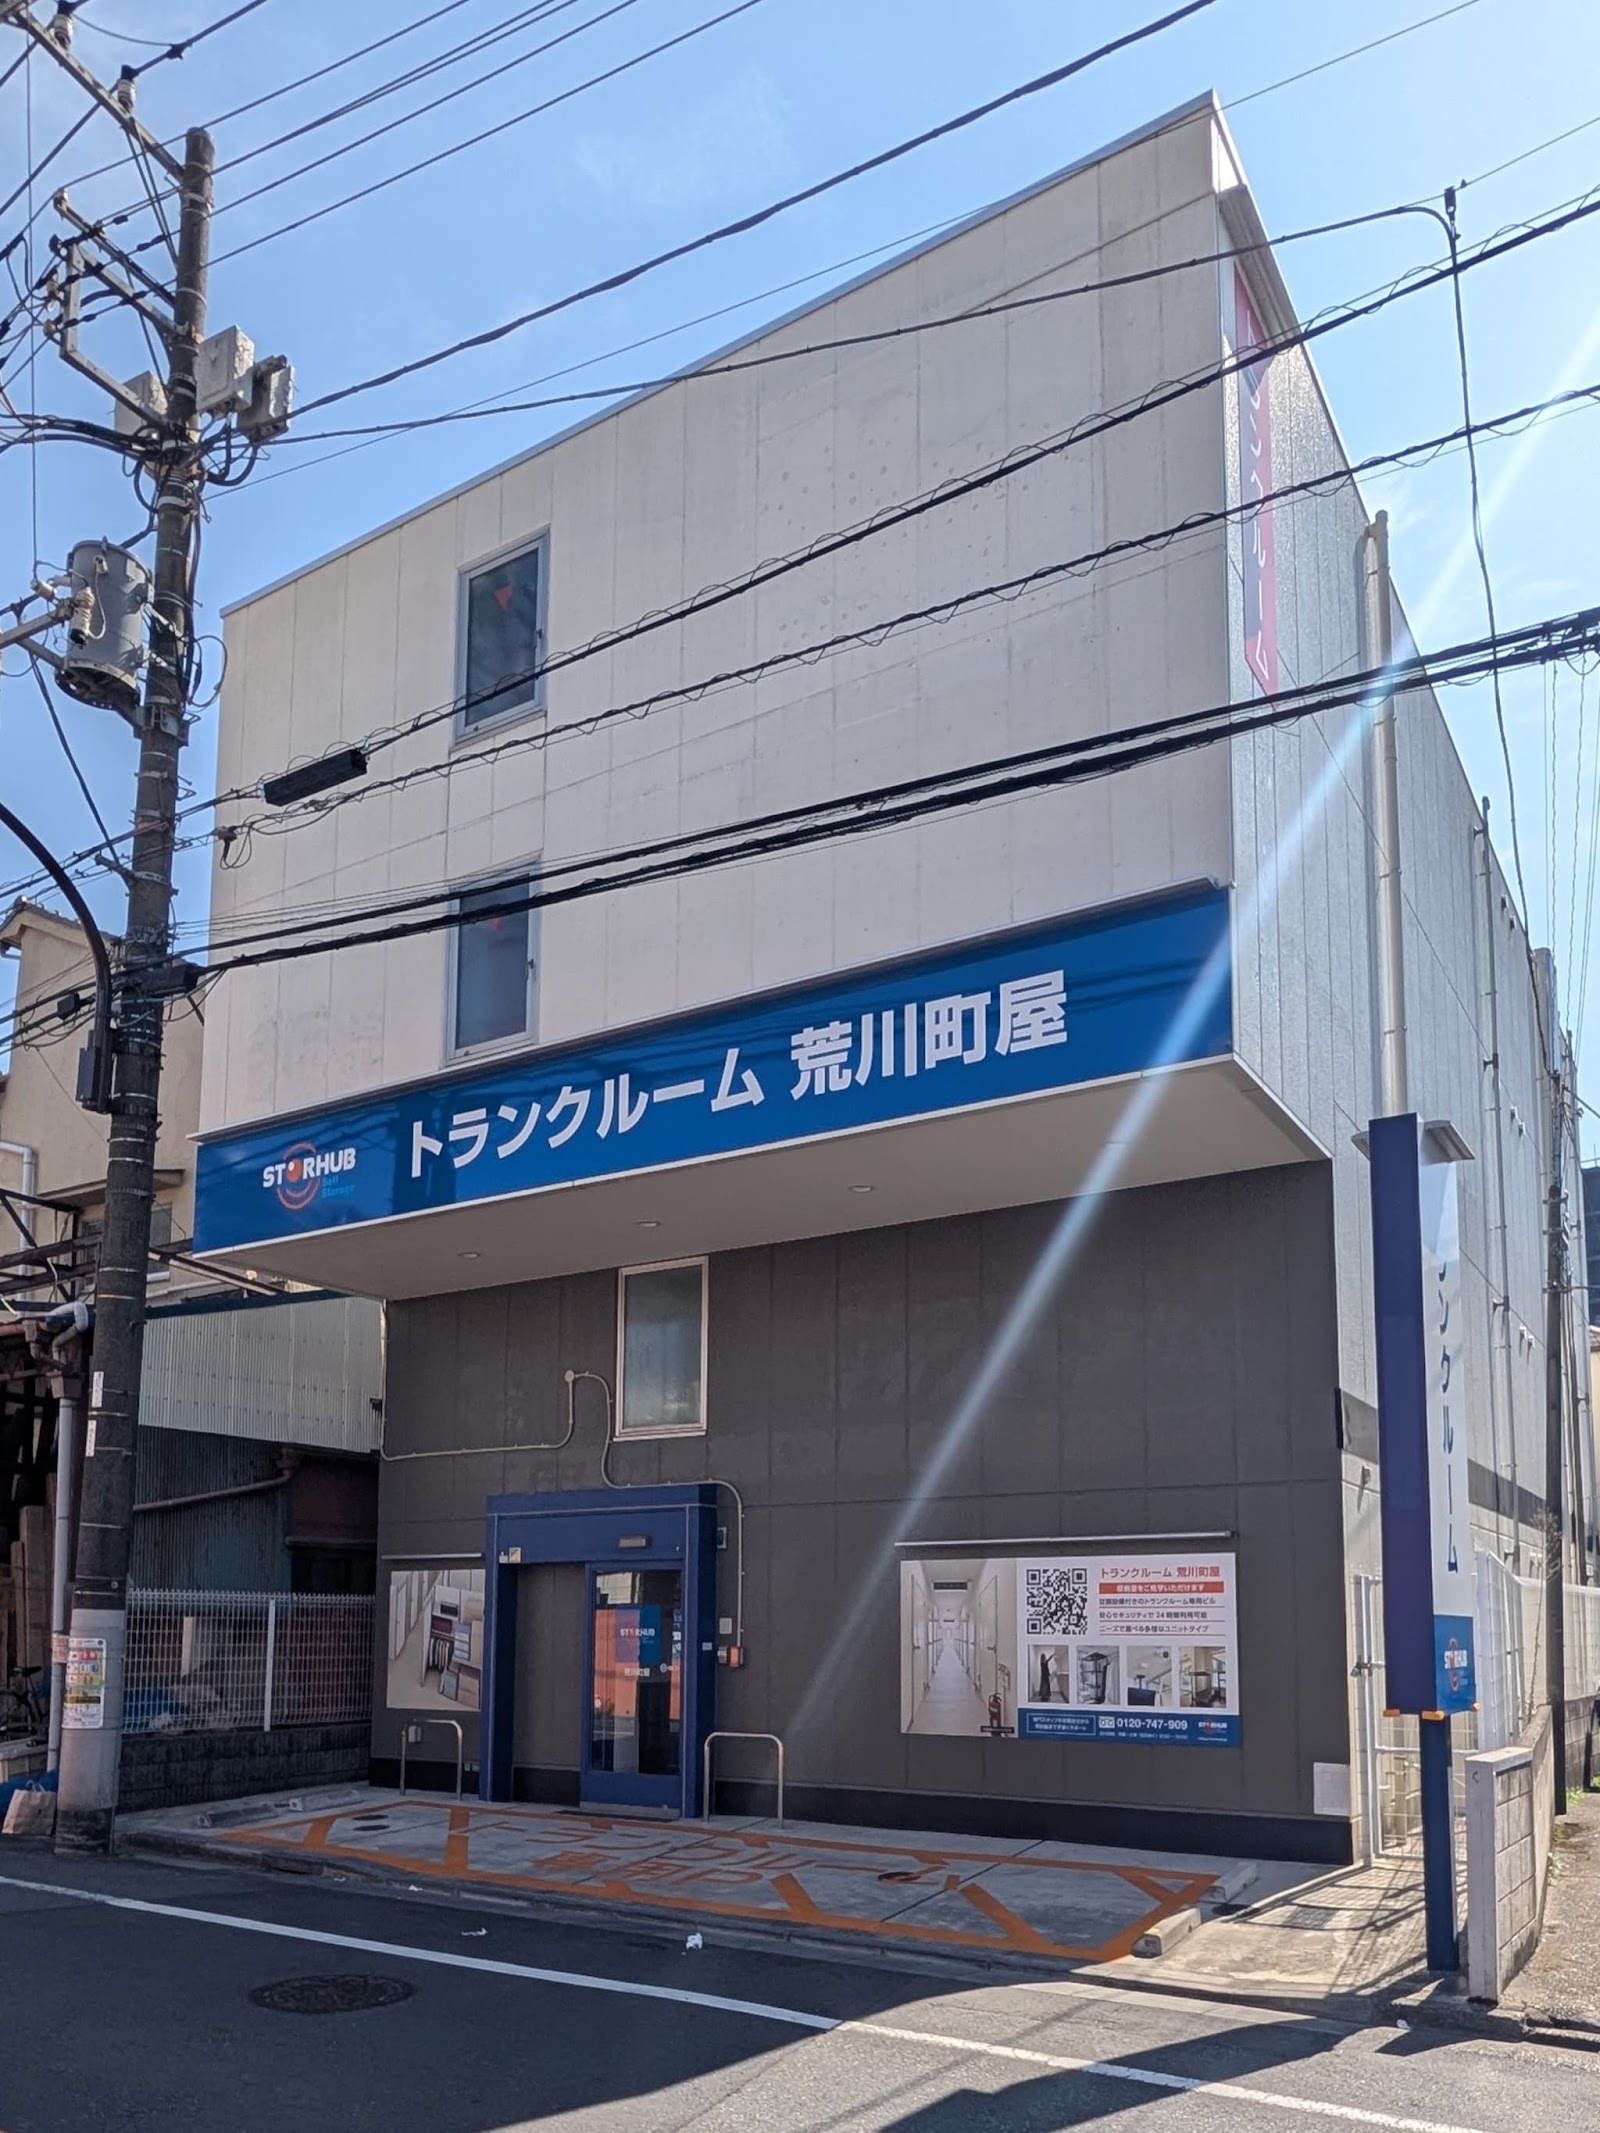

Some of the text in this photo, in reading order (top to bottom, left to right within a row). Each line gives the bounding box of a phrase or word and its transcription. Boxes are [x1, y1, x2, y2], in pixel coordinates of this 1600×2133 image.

[410, 968, 1069, 1179] トランクルーム 荒川町屋
[262, 1147, 356, 1188] STORHUB
[1100, 1565, 1220, 1579] トランクルーム 荒川町屋
[1116, 1718, 1188, 1730] 0120-747-909
